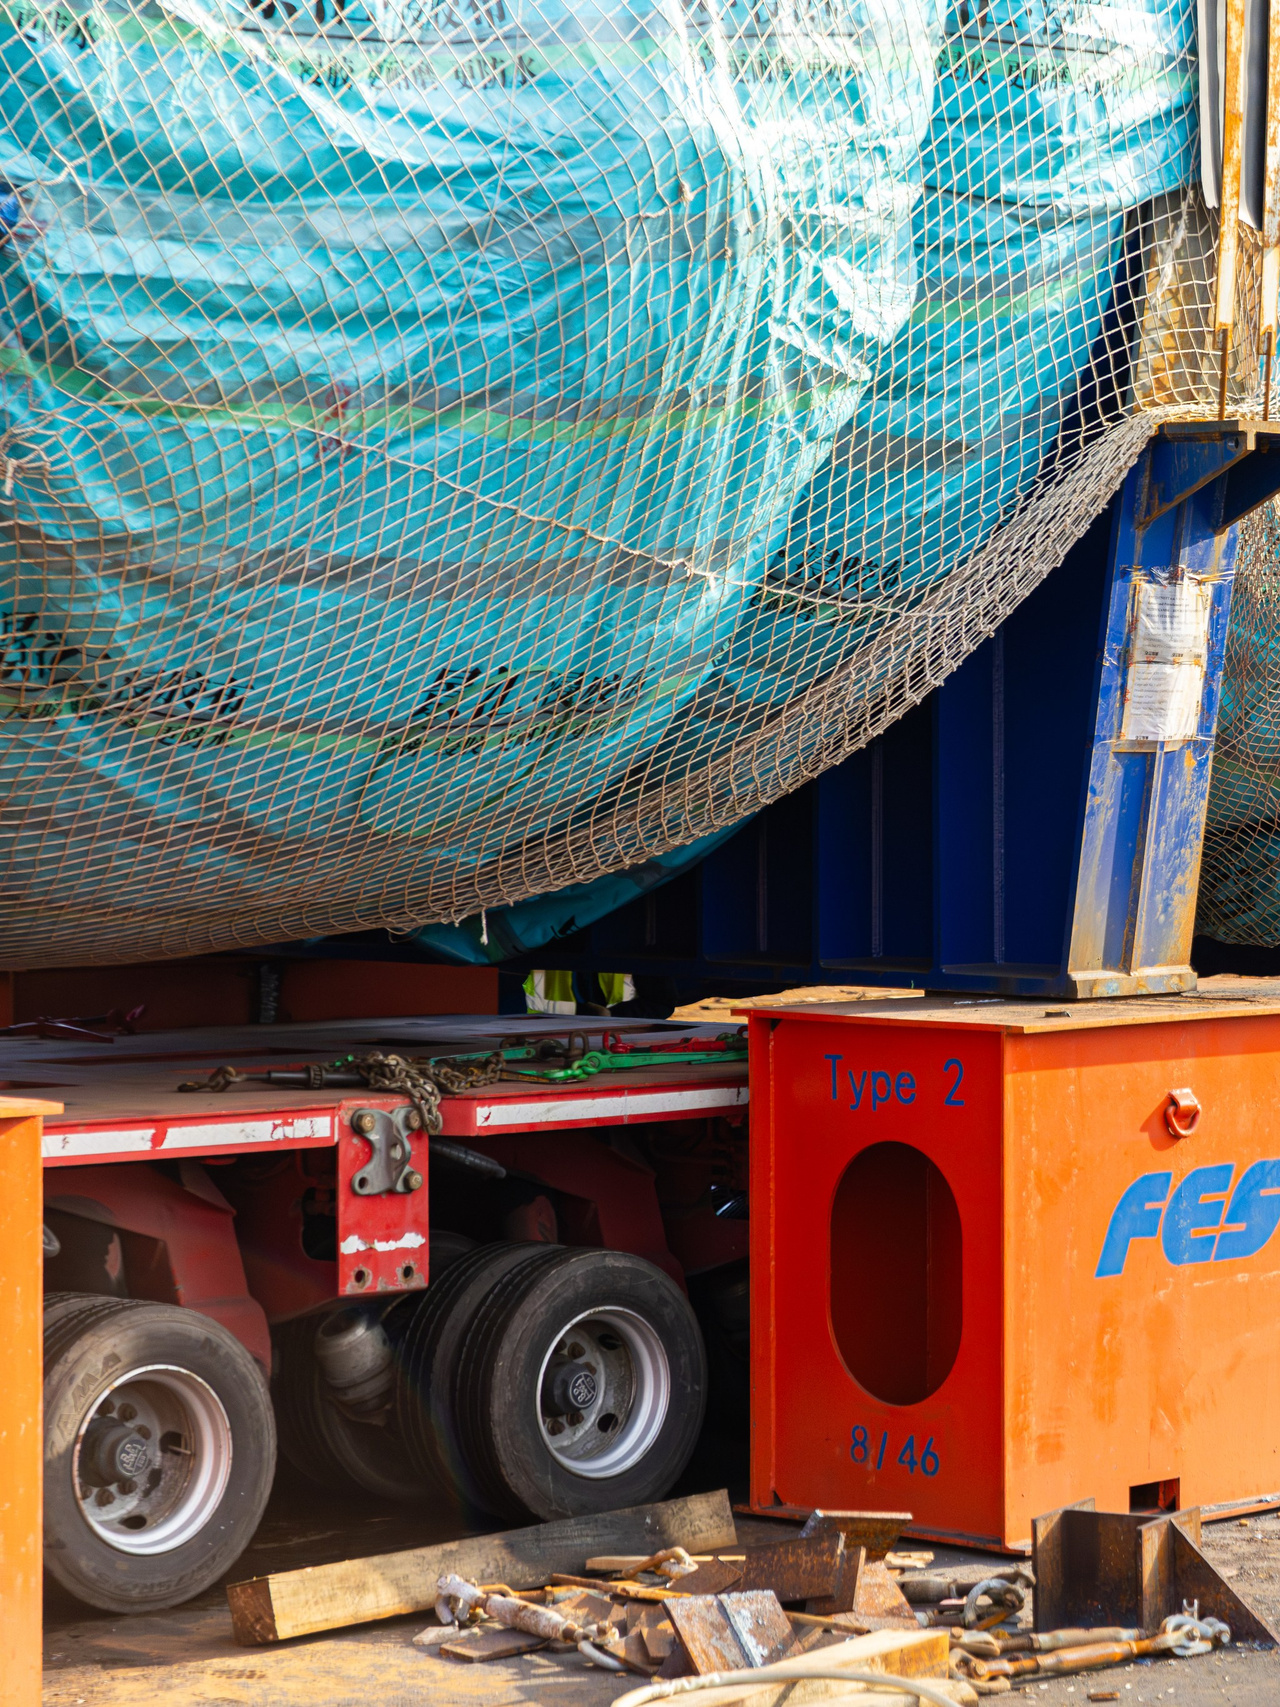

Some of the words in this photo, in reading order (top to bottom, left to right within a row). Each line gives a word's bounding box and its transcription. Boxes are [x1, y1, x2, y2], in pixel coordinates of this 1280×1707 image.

[824, 1054, 916, 1111] Type
[943, 1058, 965, 1106] 2
[850, 1425, 940, 1477] 8/46
